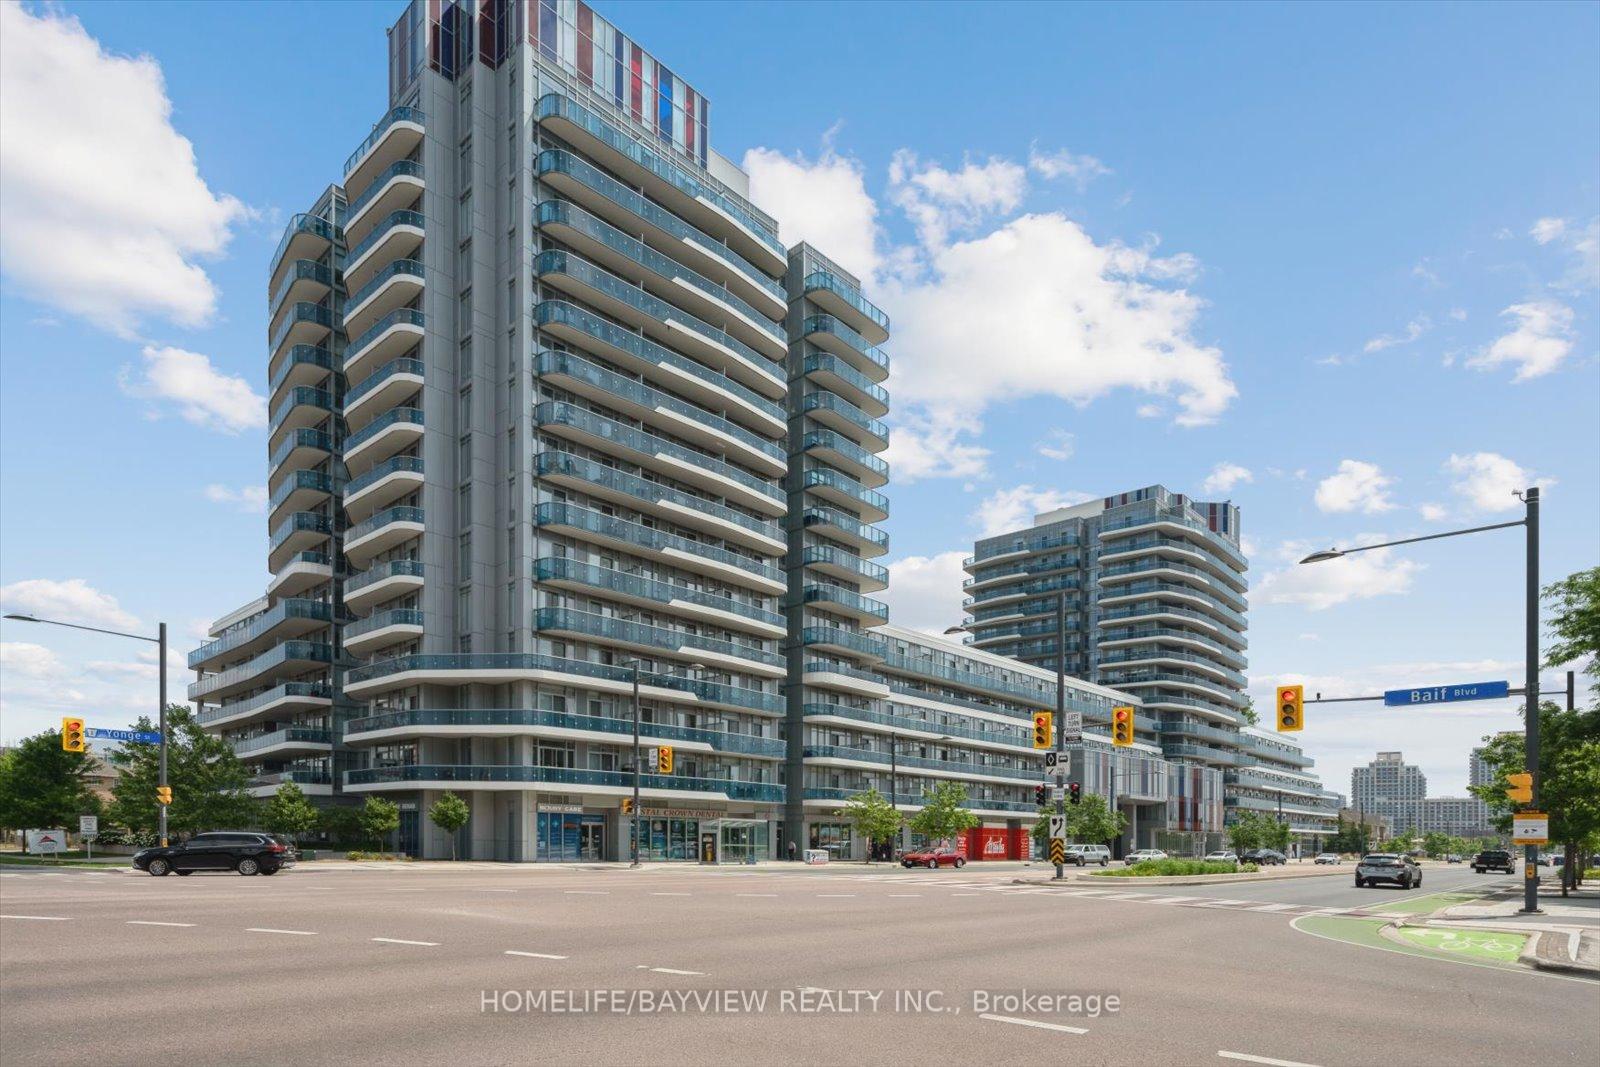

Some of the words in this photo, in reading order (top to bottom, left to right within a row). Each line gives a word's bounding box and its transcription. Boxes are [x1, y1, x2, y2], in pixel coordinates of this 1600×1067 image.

[1410, 688, 1447, 702] Baif
[1454, 687, 1477, 697] Blvd
[107, 729, 141, 740] Yonge
